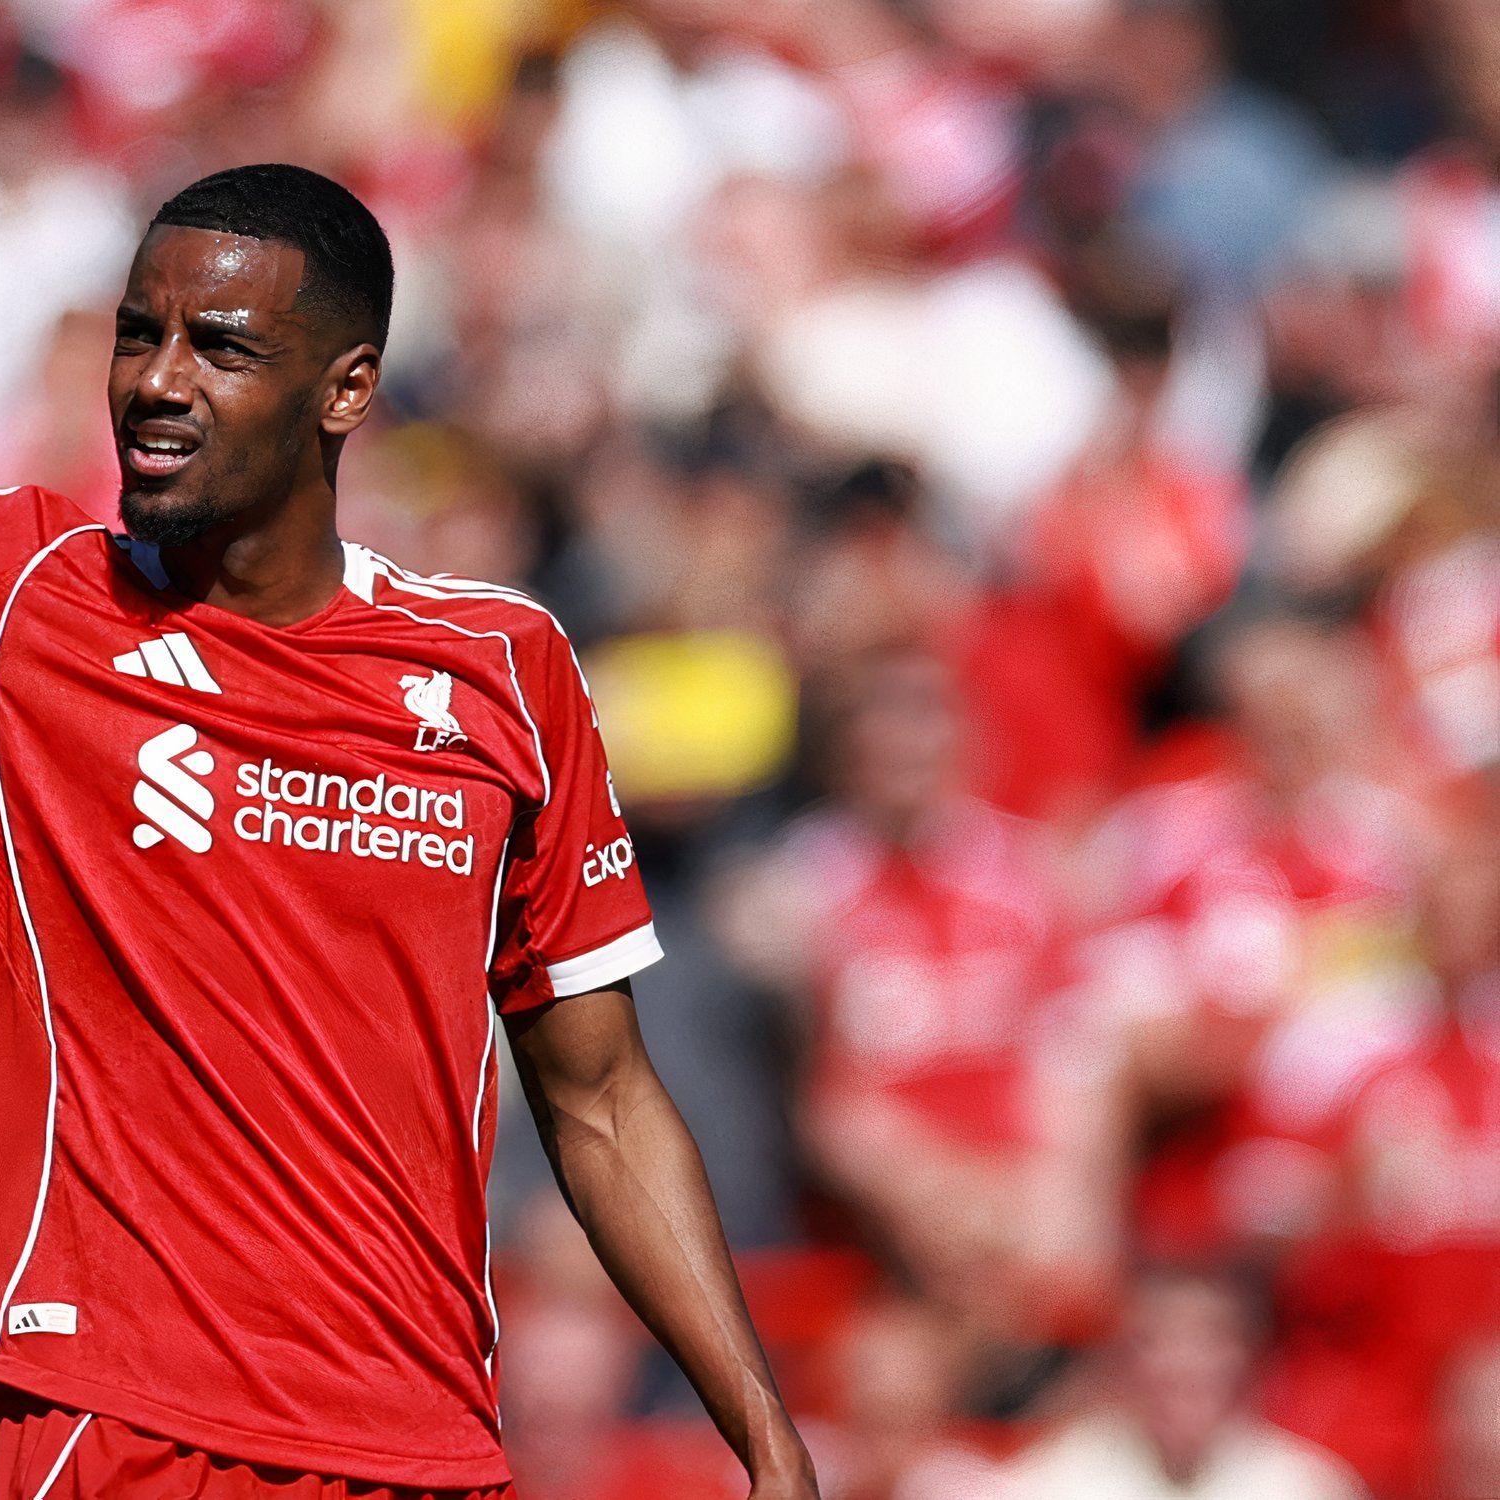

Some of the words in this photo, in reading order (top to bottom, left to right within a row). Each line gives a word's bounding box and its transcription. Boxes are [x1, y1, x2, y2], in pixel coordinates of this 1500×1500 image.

[235, 758, 464, 830] standard
[233, 801, 474, 876] chartered
[582, 832, 635, 888] Exp
